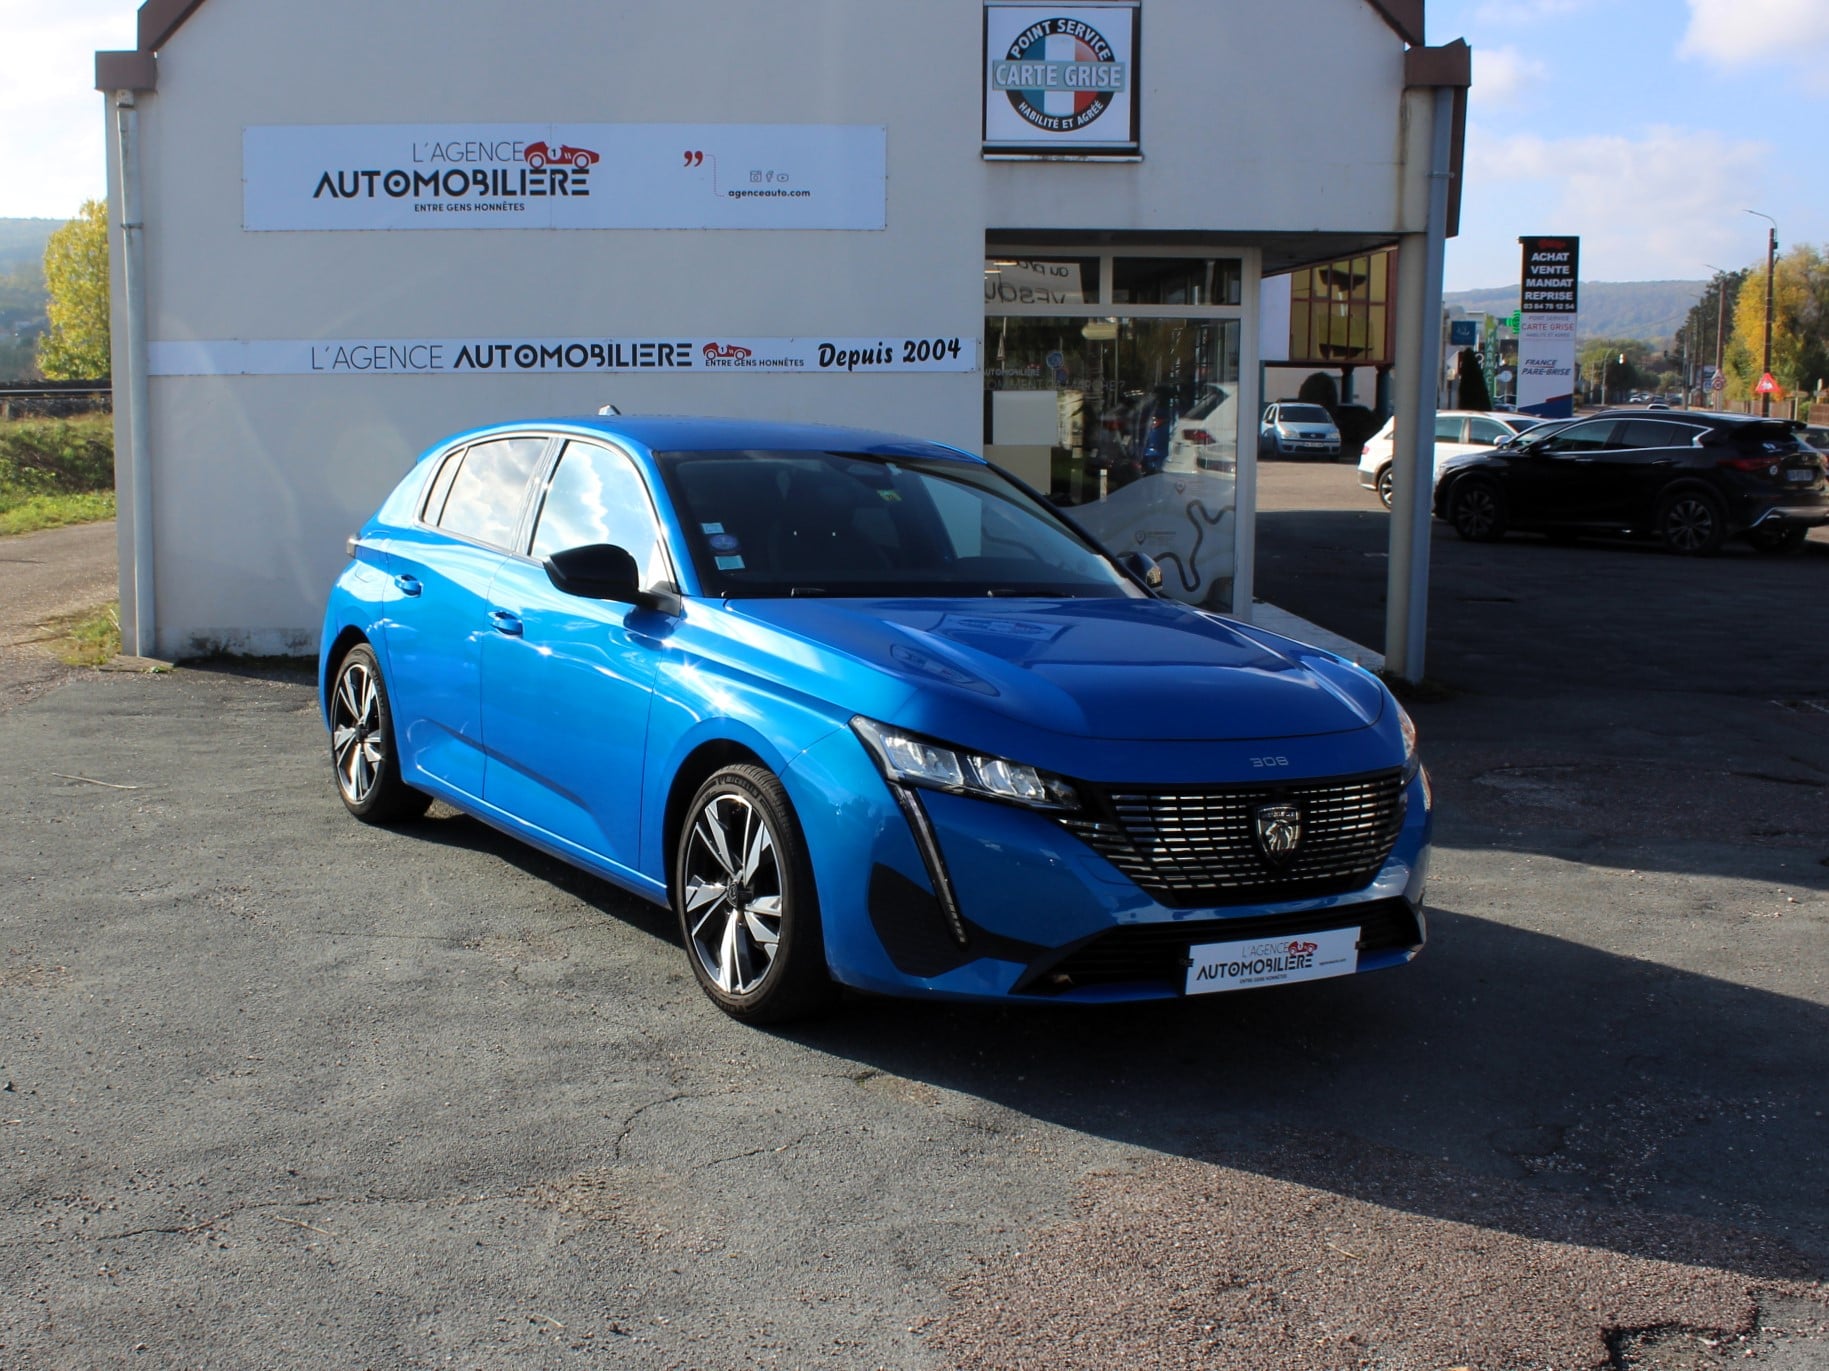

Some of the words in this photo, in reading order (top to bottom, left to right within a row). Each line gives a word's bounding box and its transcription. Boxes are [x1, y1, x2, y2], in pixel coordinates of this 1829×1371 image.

[1011, 20, 1051, 59] POINT
[1057, 19, 1111, 61] SERVICE
[996, 64, 1057, 86] CARTE
[1064, 65, 1121, 87] GRISE
[1018, 101, 1059, 129] HABILITÉ
[1062, 118, 1073, 129] ET
[412, 141, 525, 163] L'AGENCE
[728, 188, 811, 199] agenceauto.com
[414, 203, 444, 212] ENTRE
[446, 203, 472, 212] GENS
[474, 200, 526, 212] HONNÊTES
[1531, 252, 1570, 262] ACHAT
[1530, 265, 1570, 275] VENTE
[1525, 278, 1574, 288] MANDAT
[1524, 291, 1573, 301] REPRISE
[311, 345, 444, 370] L'AGENCE
[817, 342, 893, 371] Depuis
[902, 337, 962, 363] 2004
[705, 359, 732, 367] ENTRE
[734, 359, 756, 367] GENS
[759, 356, 805, 367] HONNÊTES
[1521, 368, 1571, 376] PARE-BRISE
[1249, 756, 1289, 768] 308
[1242, 942, 1288, 958] L'AGENCE
